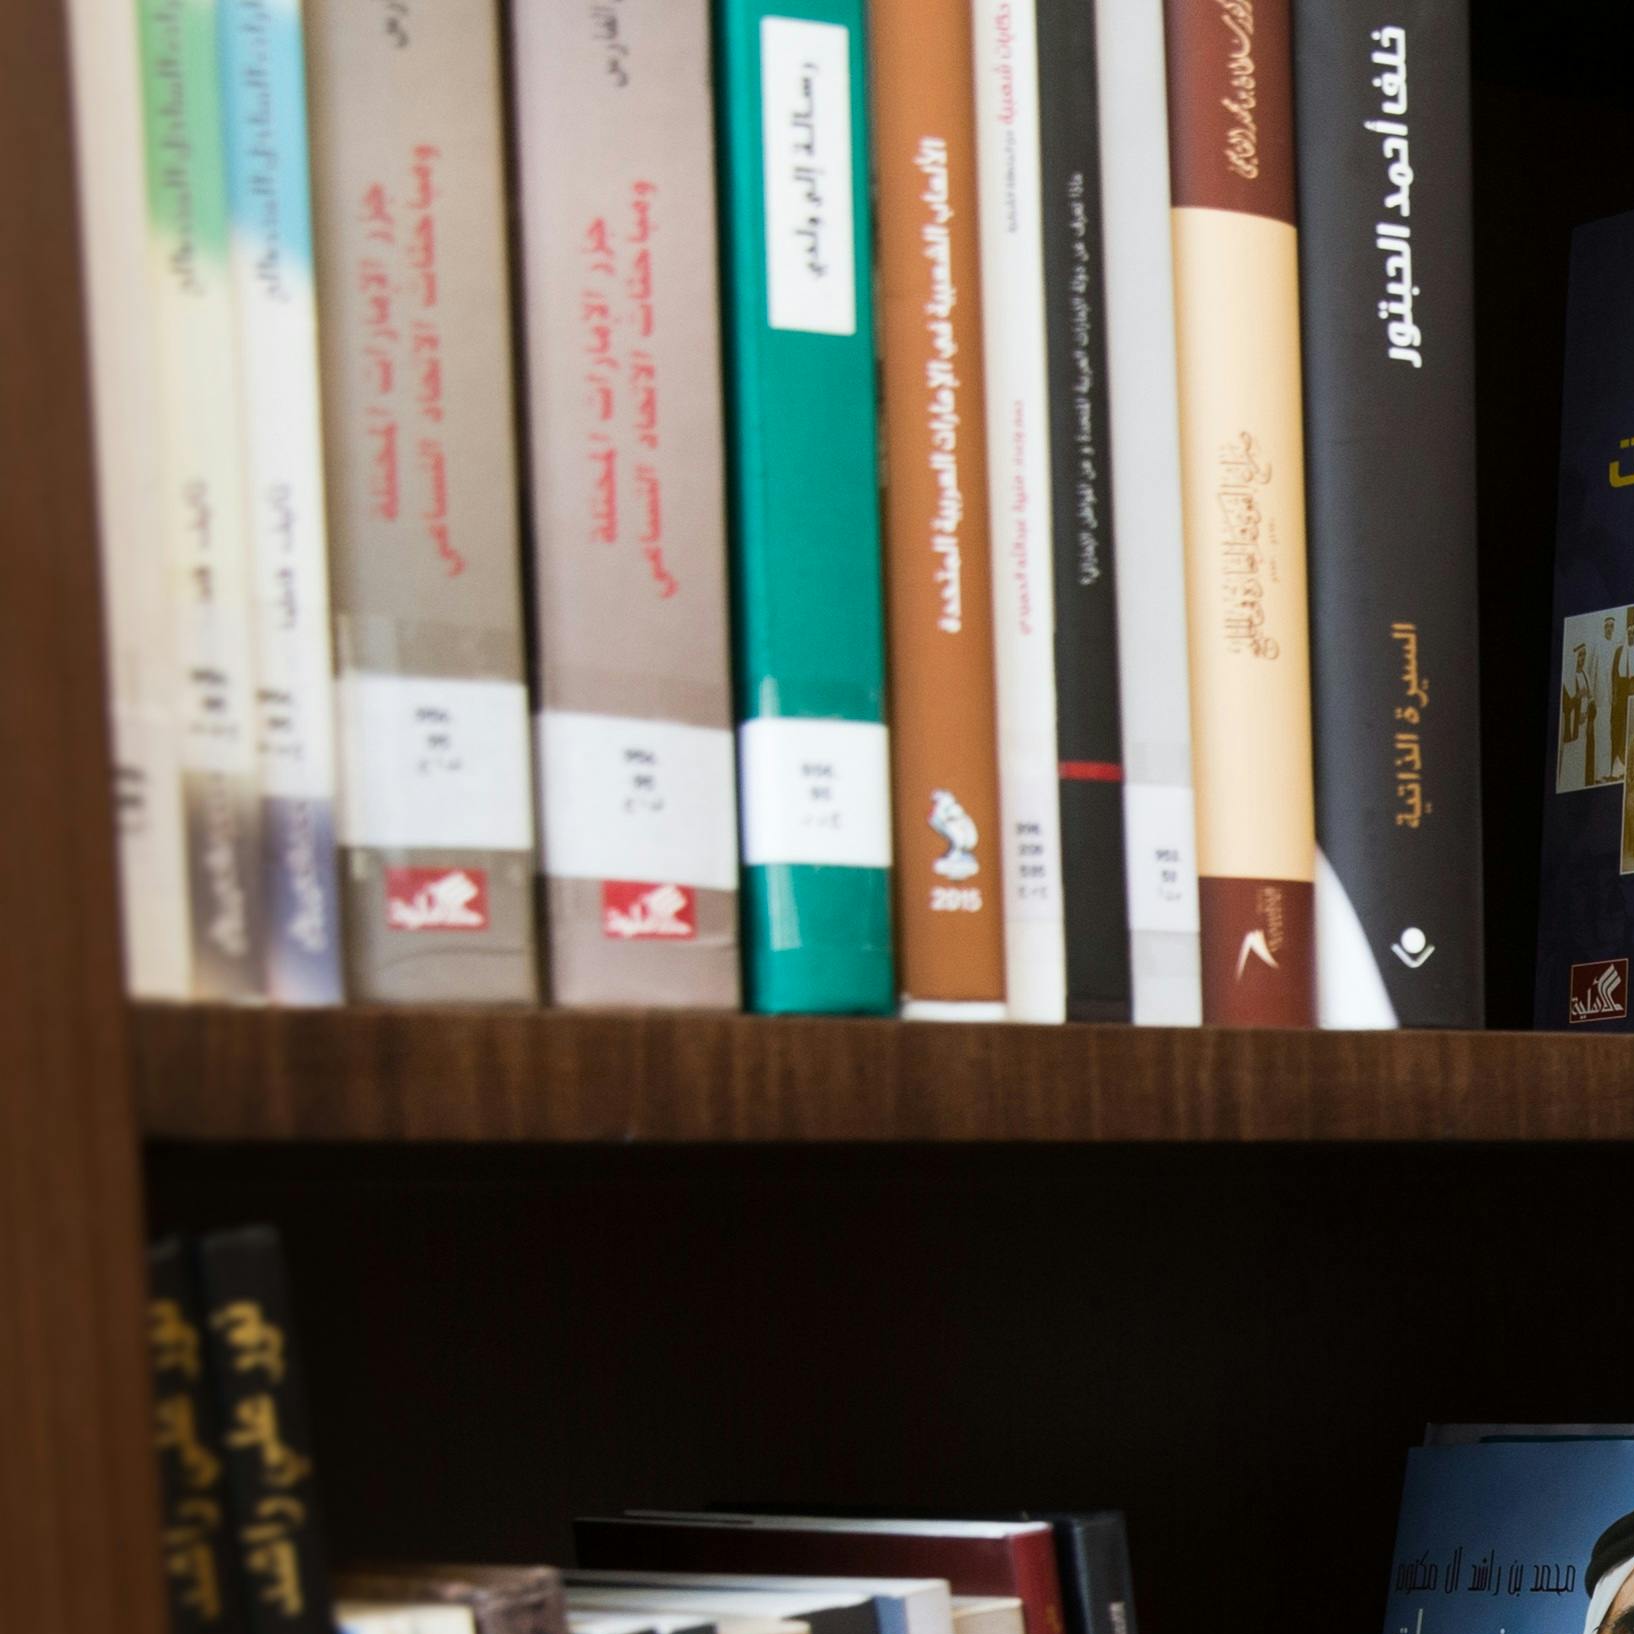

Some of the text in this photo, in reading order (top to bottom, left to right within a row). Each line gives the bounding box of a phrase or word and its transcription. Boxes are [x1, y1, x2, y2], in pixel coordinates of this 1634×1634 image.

[1366, 26, 1423, 367] خلف أحمد الحبتور
[1392, 623, 1427, 828] السيرة الذاتية
[930, 888, 982, 912] 2015
